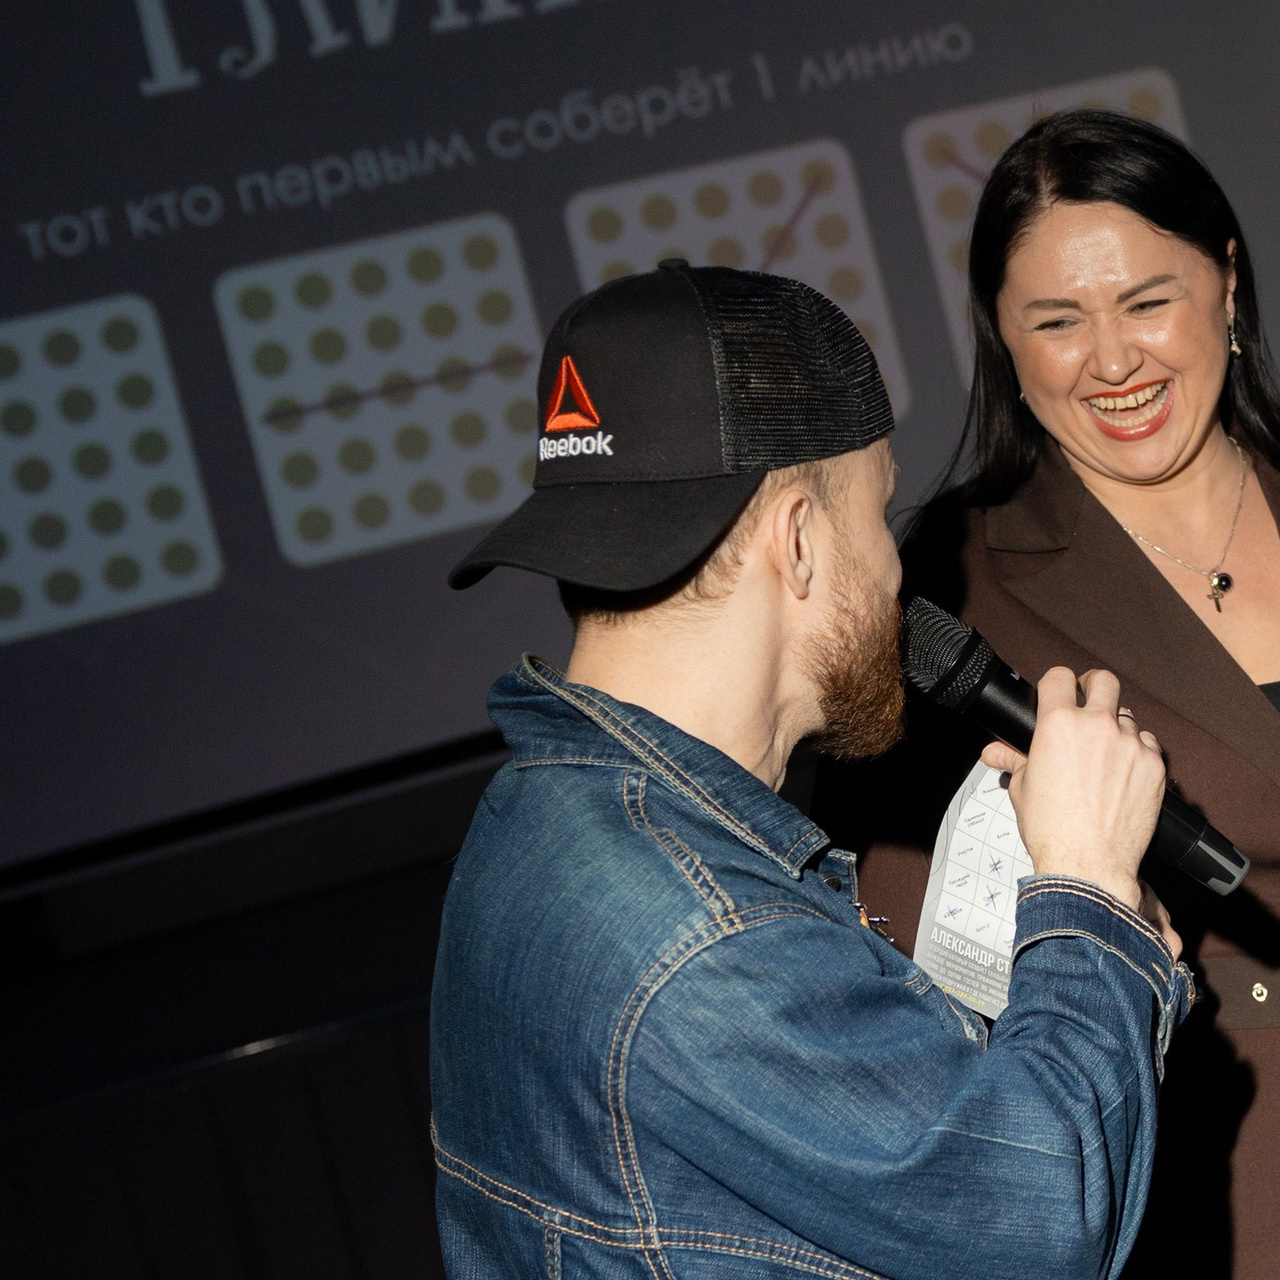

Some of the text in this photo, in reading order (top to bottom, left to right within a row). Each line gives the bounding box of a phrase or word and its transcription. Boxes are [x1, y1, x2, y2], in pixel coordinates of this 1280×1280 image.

[19, 22, 974, 261] тот кто первым соберёт 1 линию
[539, 430, 614, 461] Reebok
[930, 926, 995, 968] АЛЕКСАНДР
